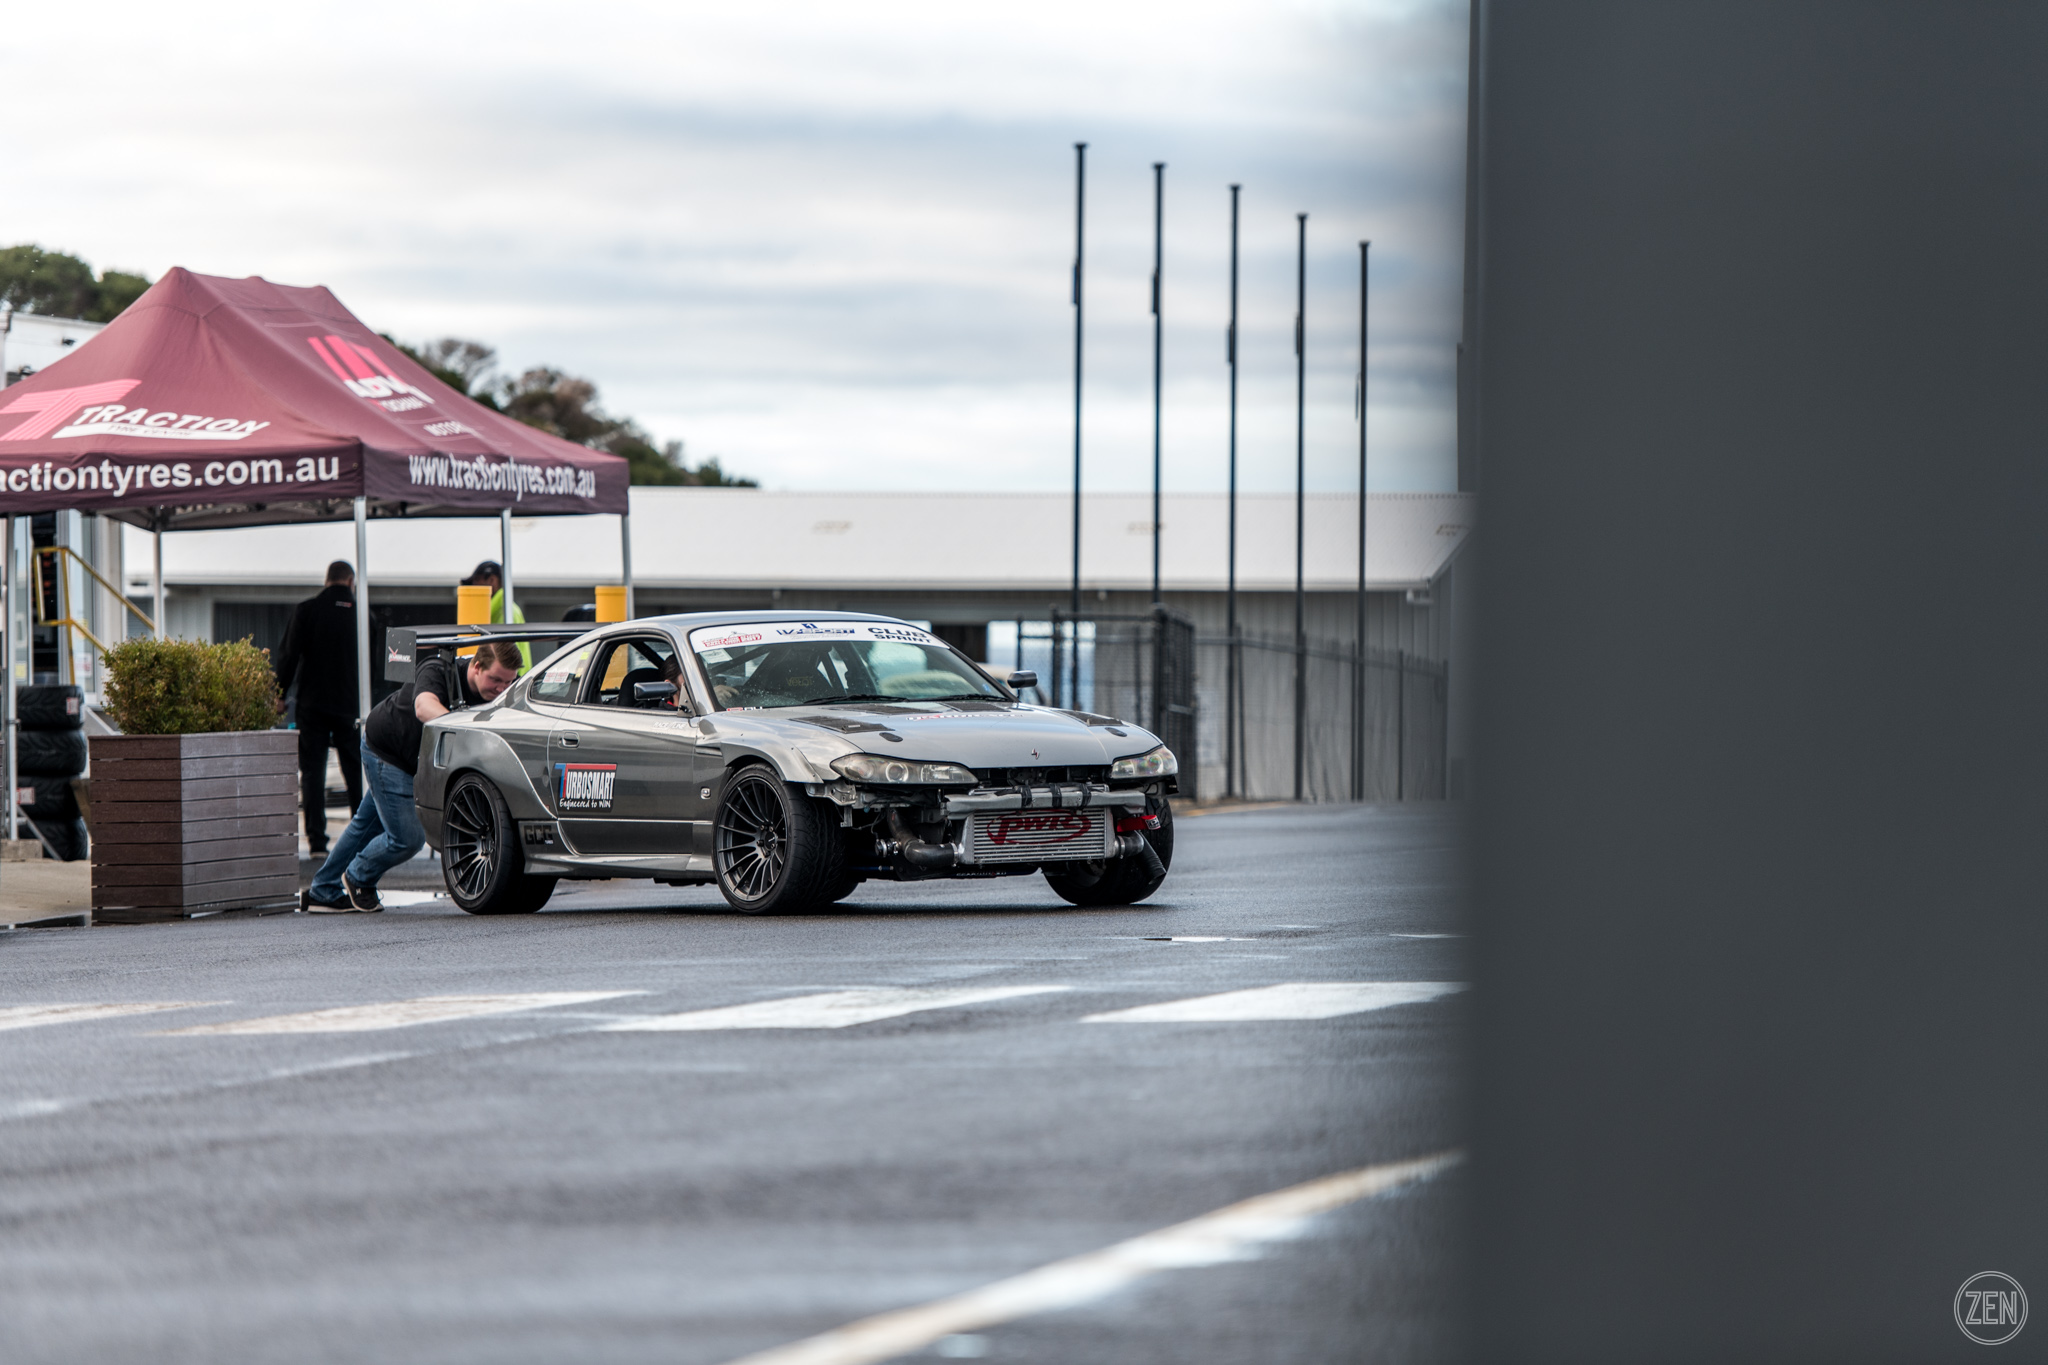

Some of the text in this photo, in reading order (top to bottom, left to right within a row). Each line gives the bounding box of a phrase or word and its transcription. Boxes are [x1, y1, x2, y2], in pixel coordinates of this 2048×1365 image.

[73, 404, 271, 433] TRACTION
[409, 454, 596, 502] www.tractiontyres.com.au
[868, 627, 927, 638] CLUB
[874, 634, 931, 643] SPRINT
[554, 763, 617, 799] TURBOSMART
